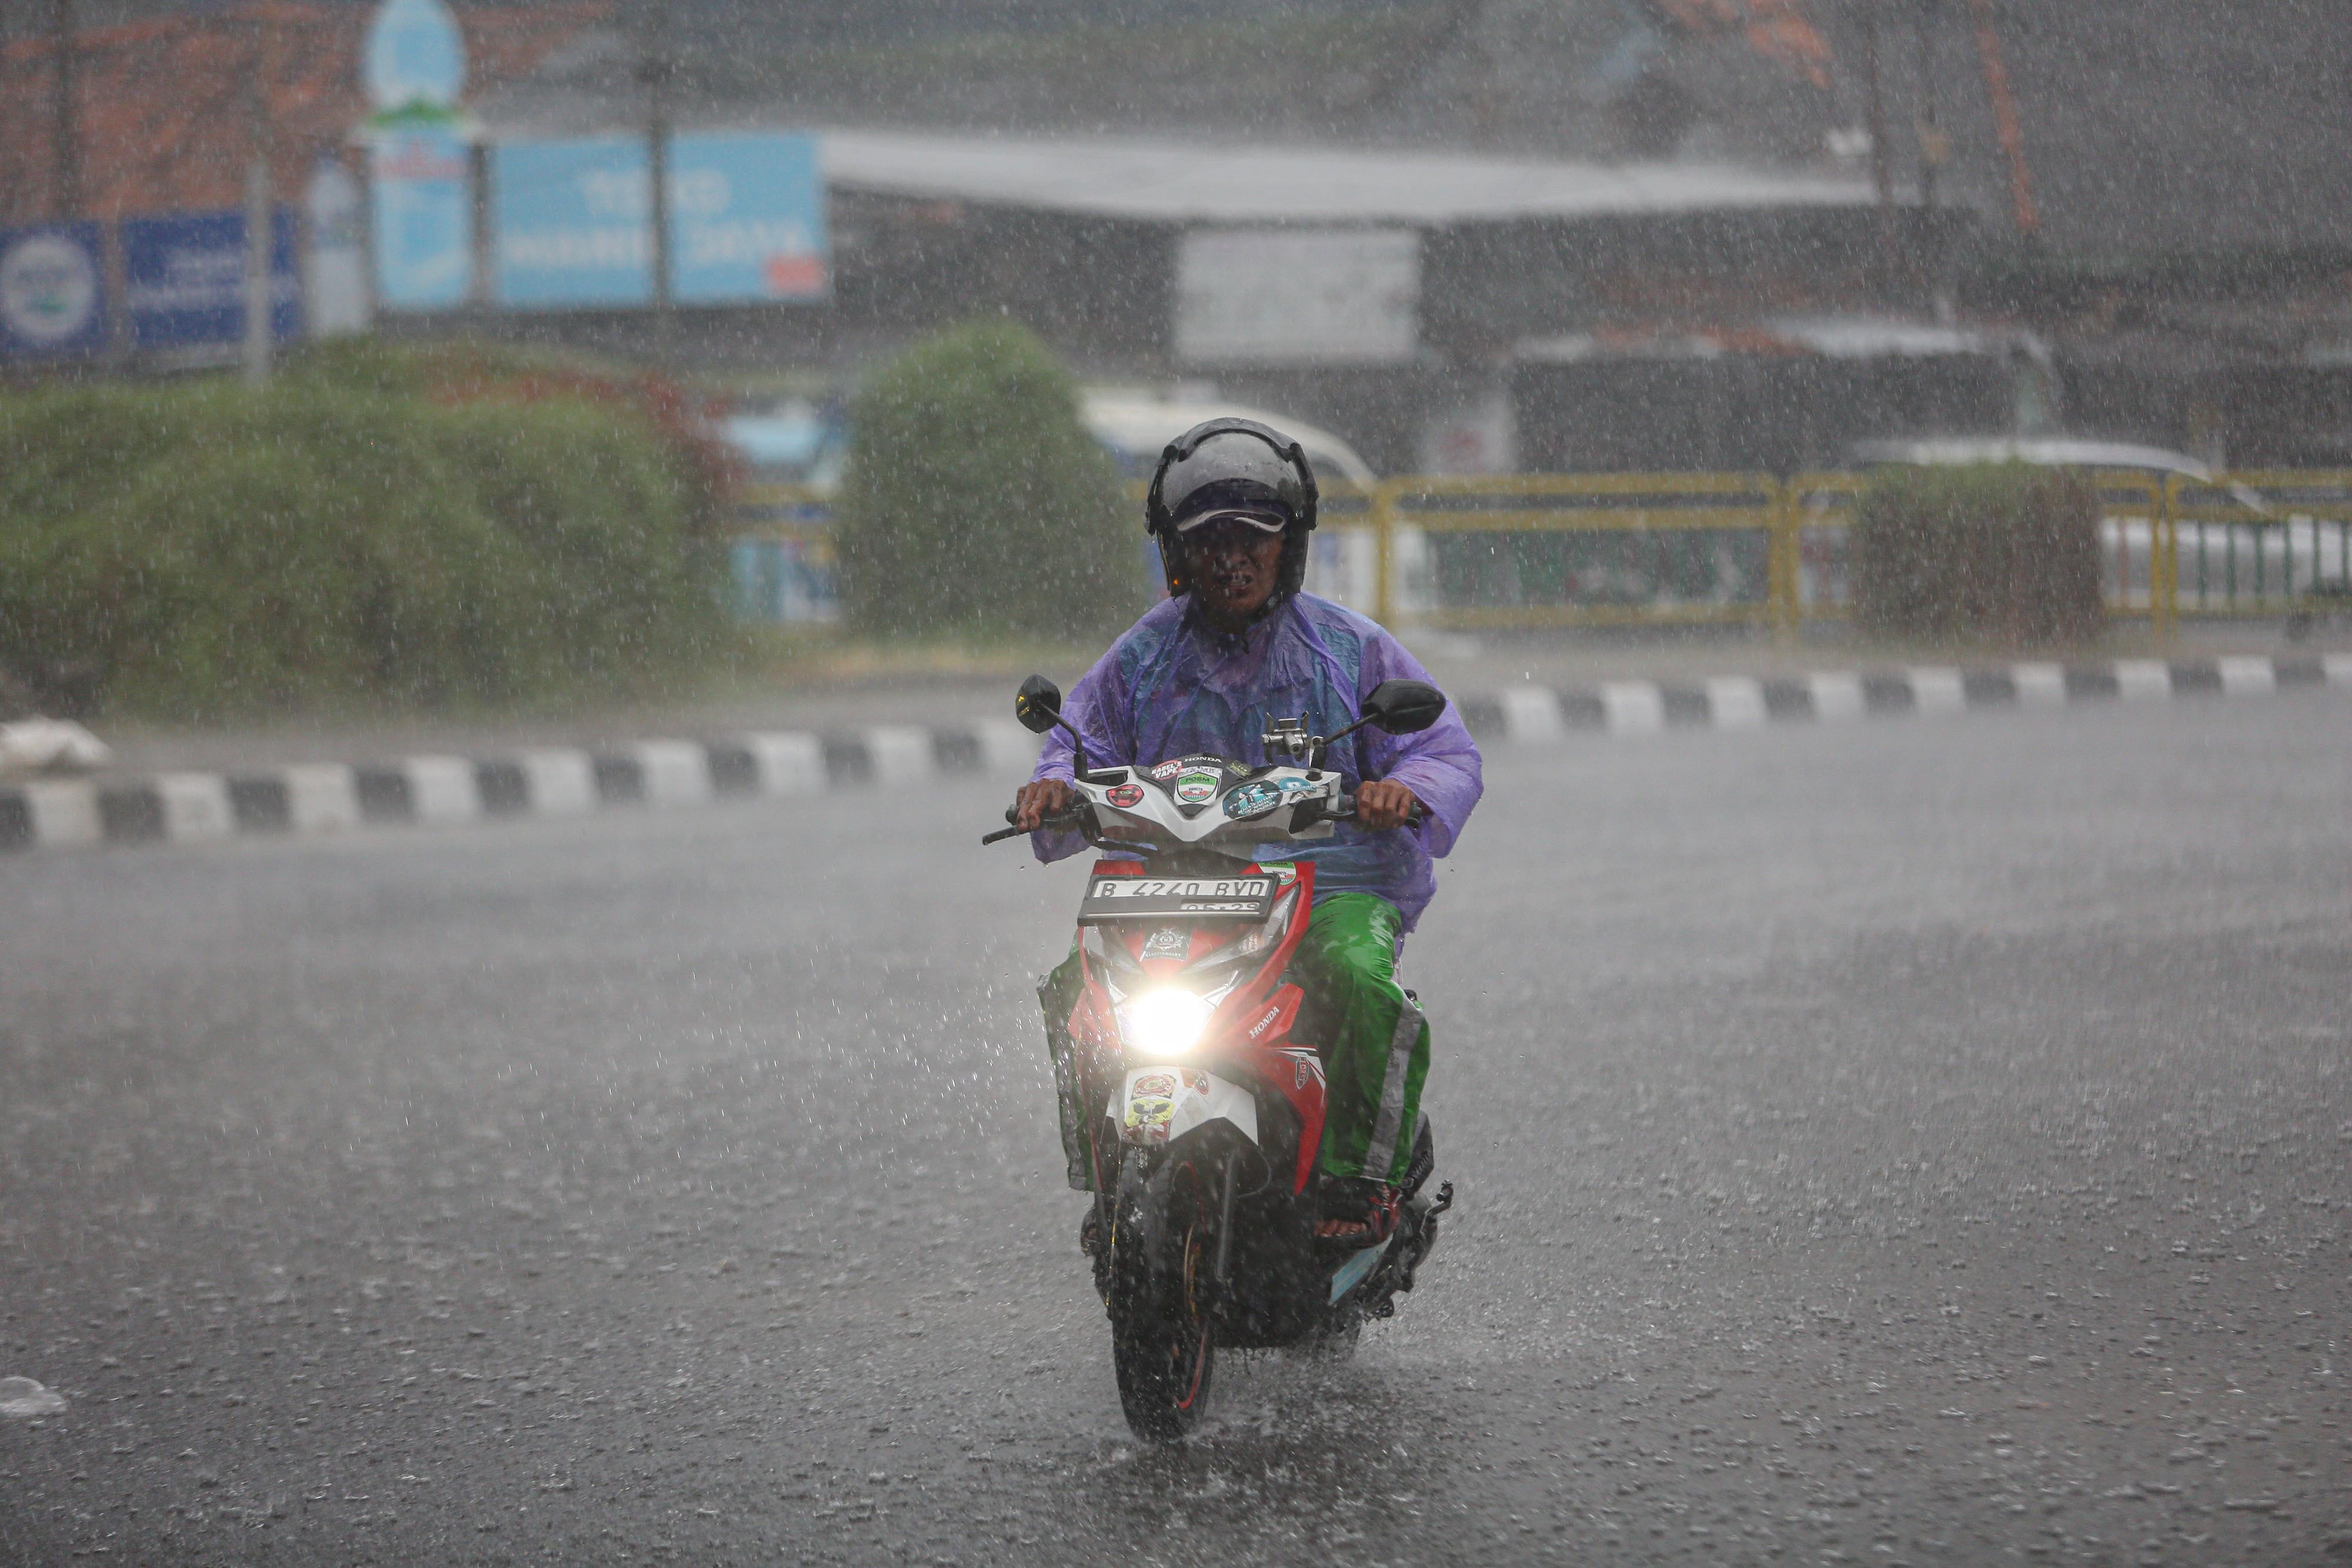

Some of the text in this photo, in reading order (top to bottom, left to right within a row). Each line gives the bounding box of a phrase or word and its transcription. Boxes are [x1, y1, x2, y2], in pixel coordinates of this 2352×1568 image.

[1156, 767, 1178, 779] VAPE
[1101, 883, 1117, 897] B
[1132, 882, 1200, 897] 4240
[1249, 1006, 1279, 1039] HONDA
